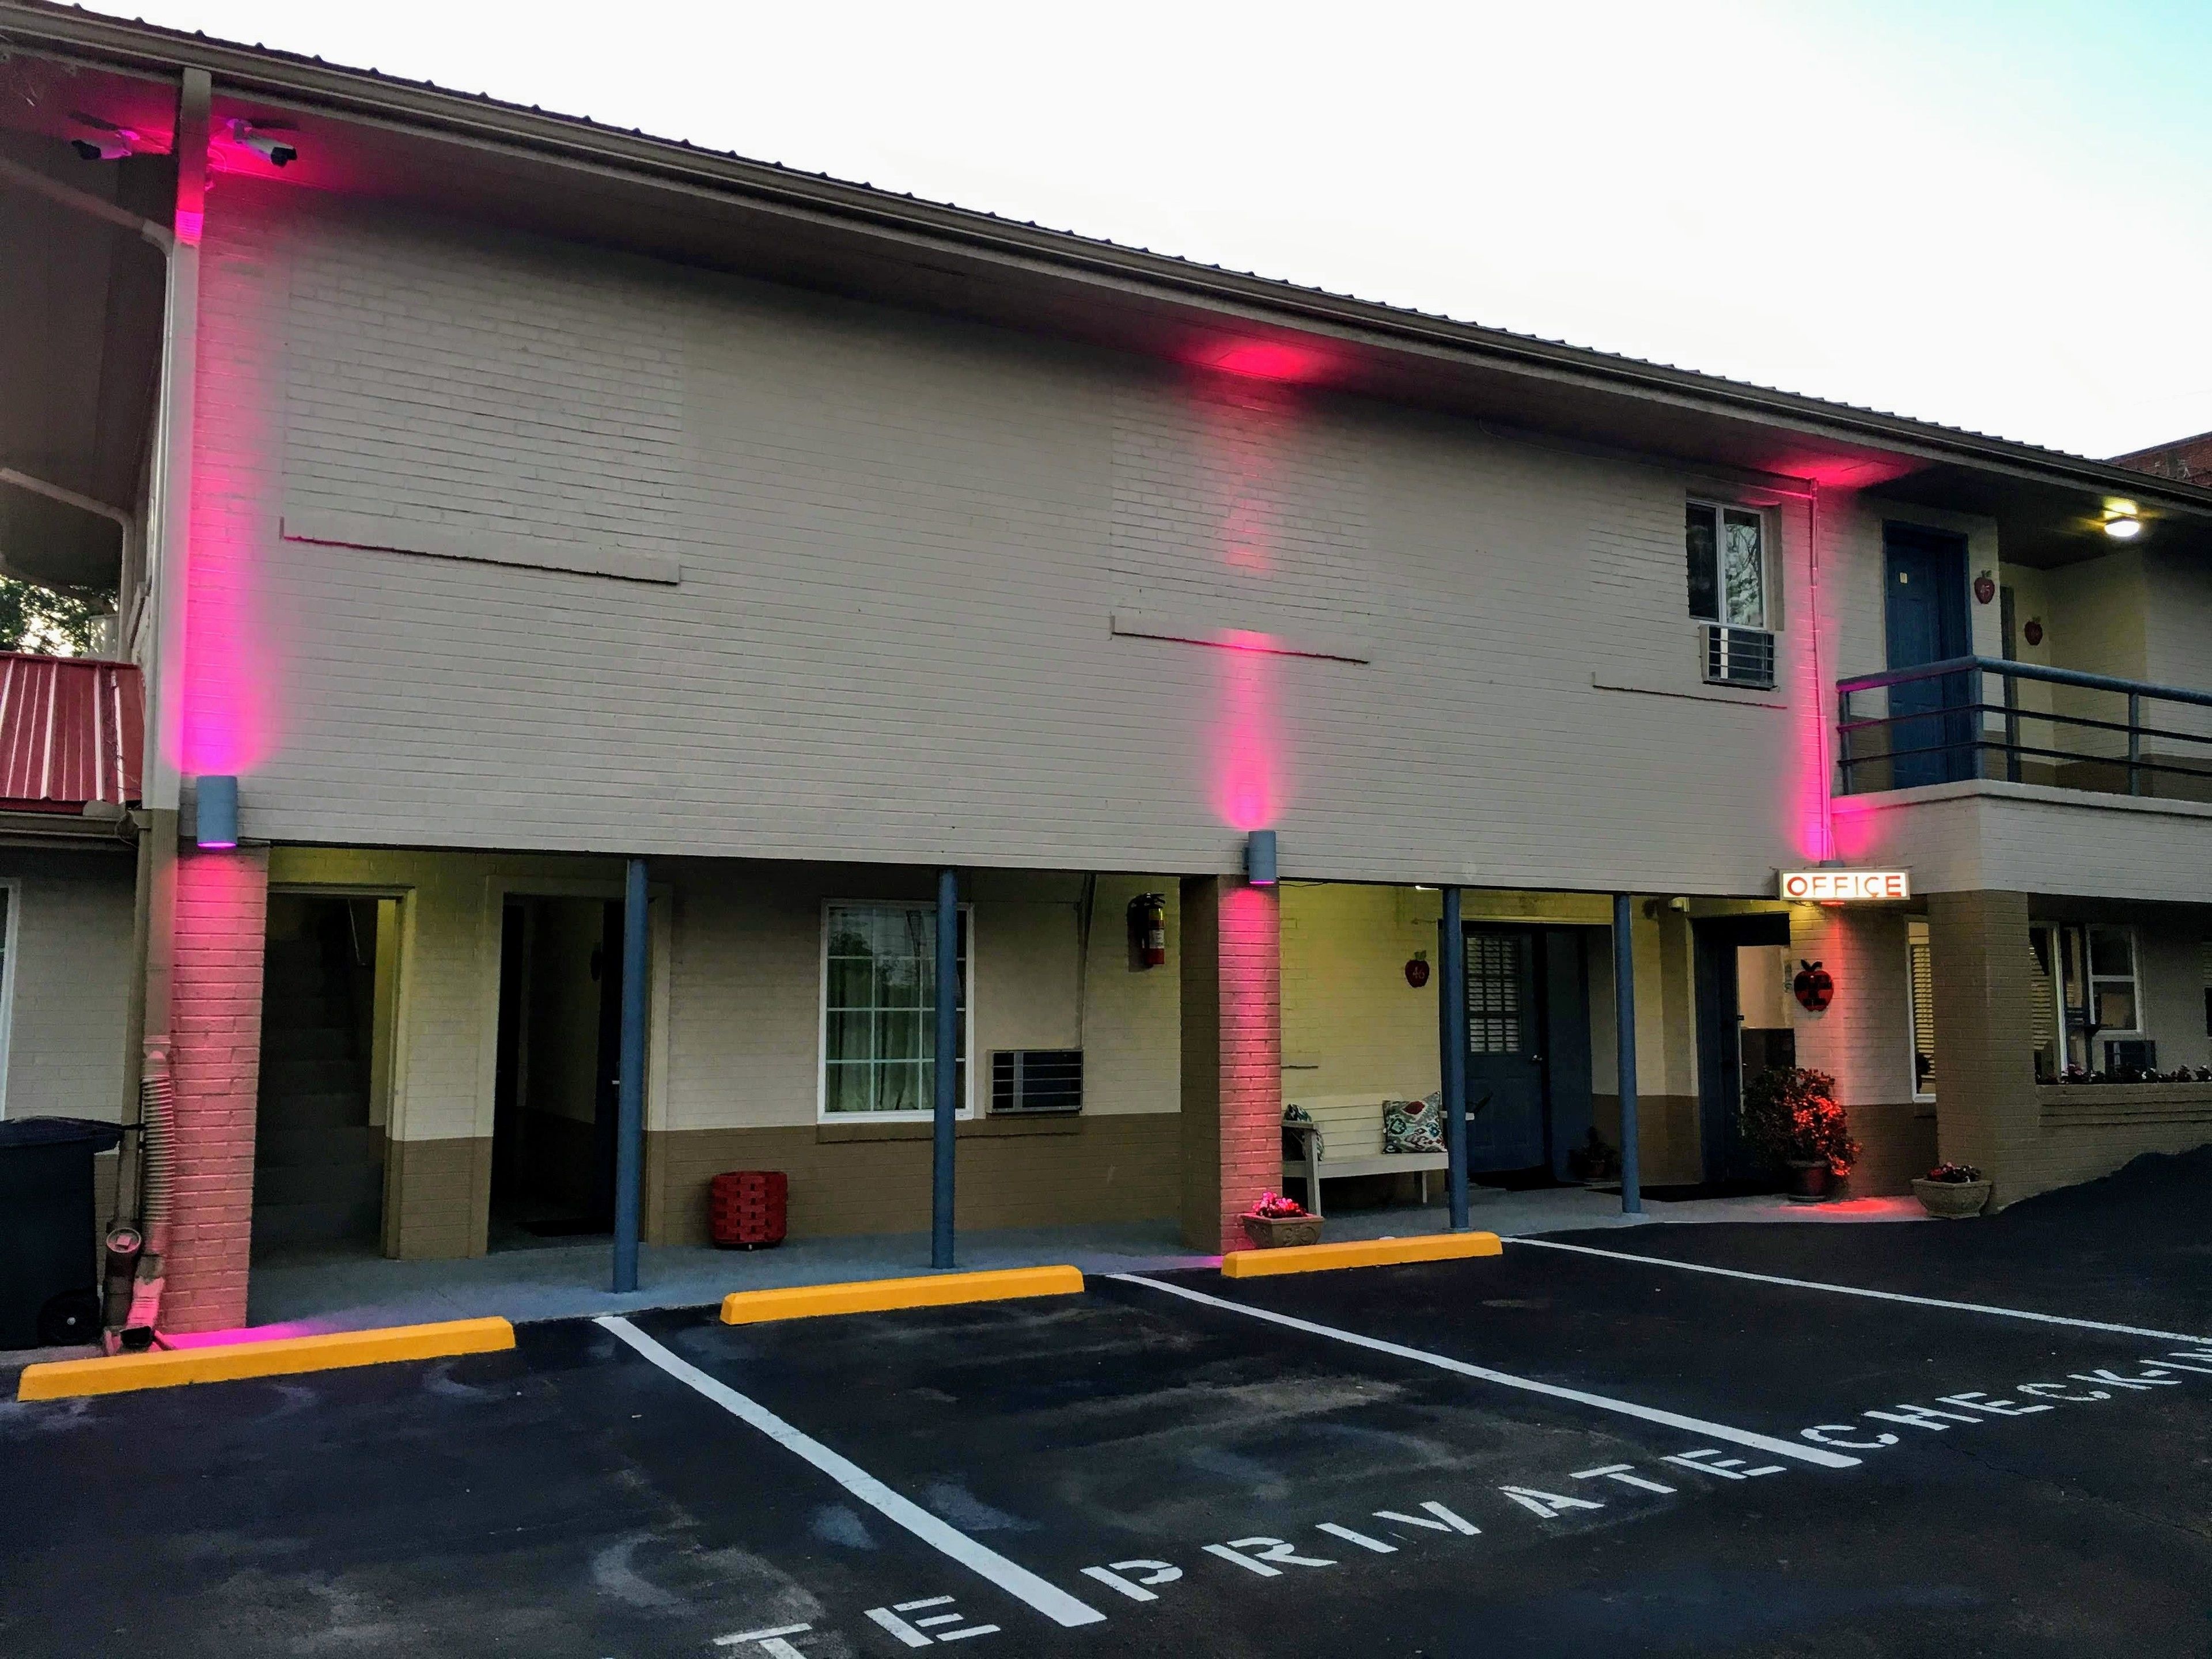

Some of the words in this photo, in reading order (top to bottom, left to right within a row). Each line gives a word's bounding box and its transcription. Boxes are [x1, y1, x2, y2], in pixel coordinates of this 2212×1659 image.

[1787, 876, 1902, 897] OFFICE
[1412, 967, 1425, 979] 46
[1080, 1448, 1787, 1602] PRIVATE
